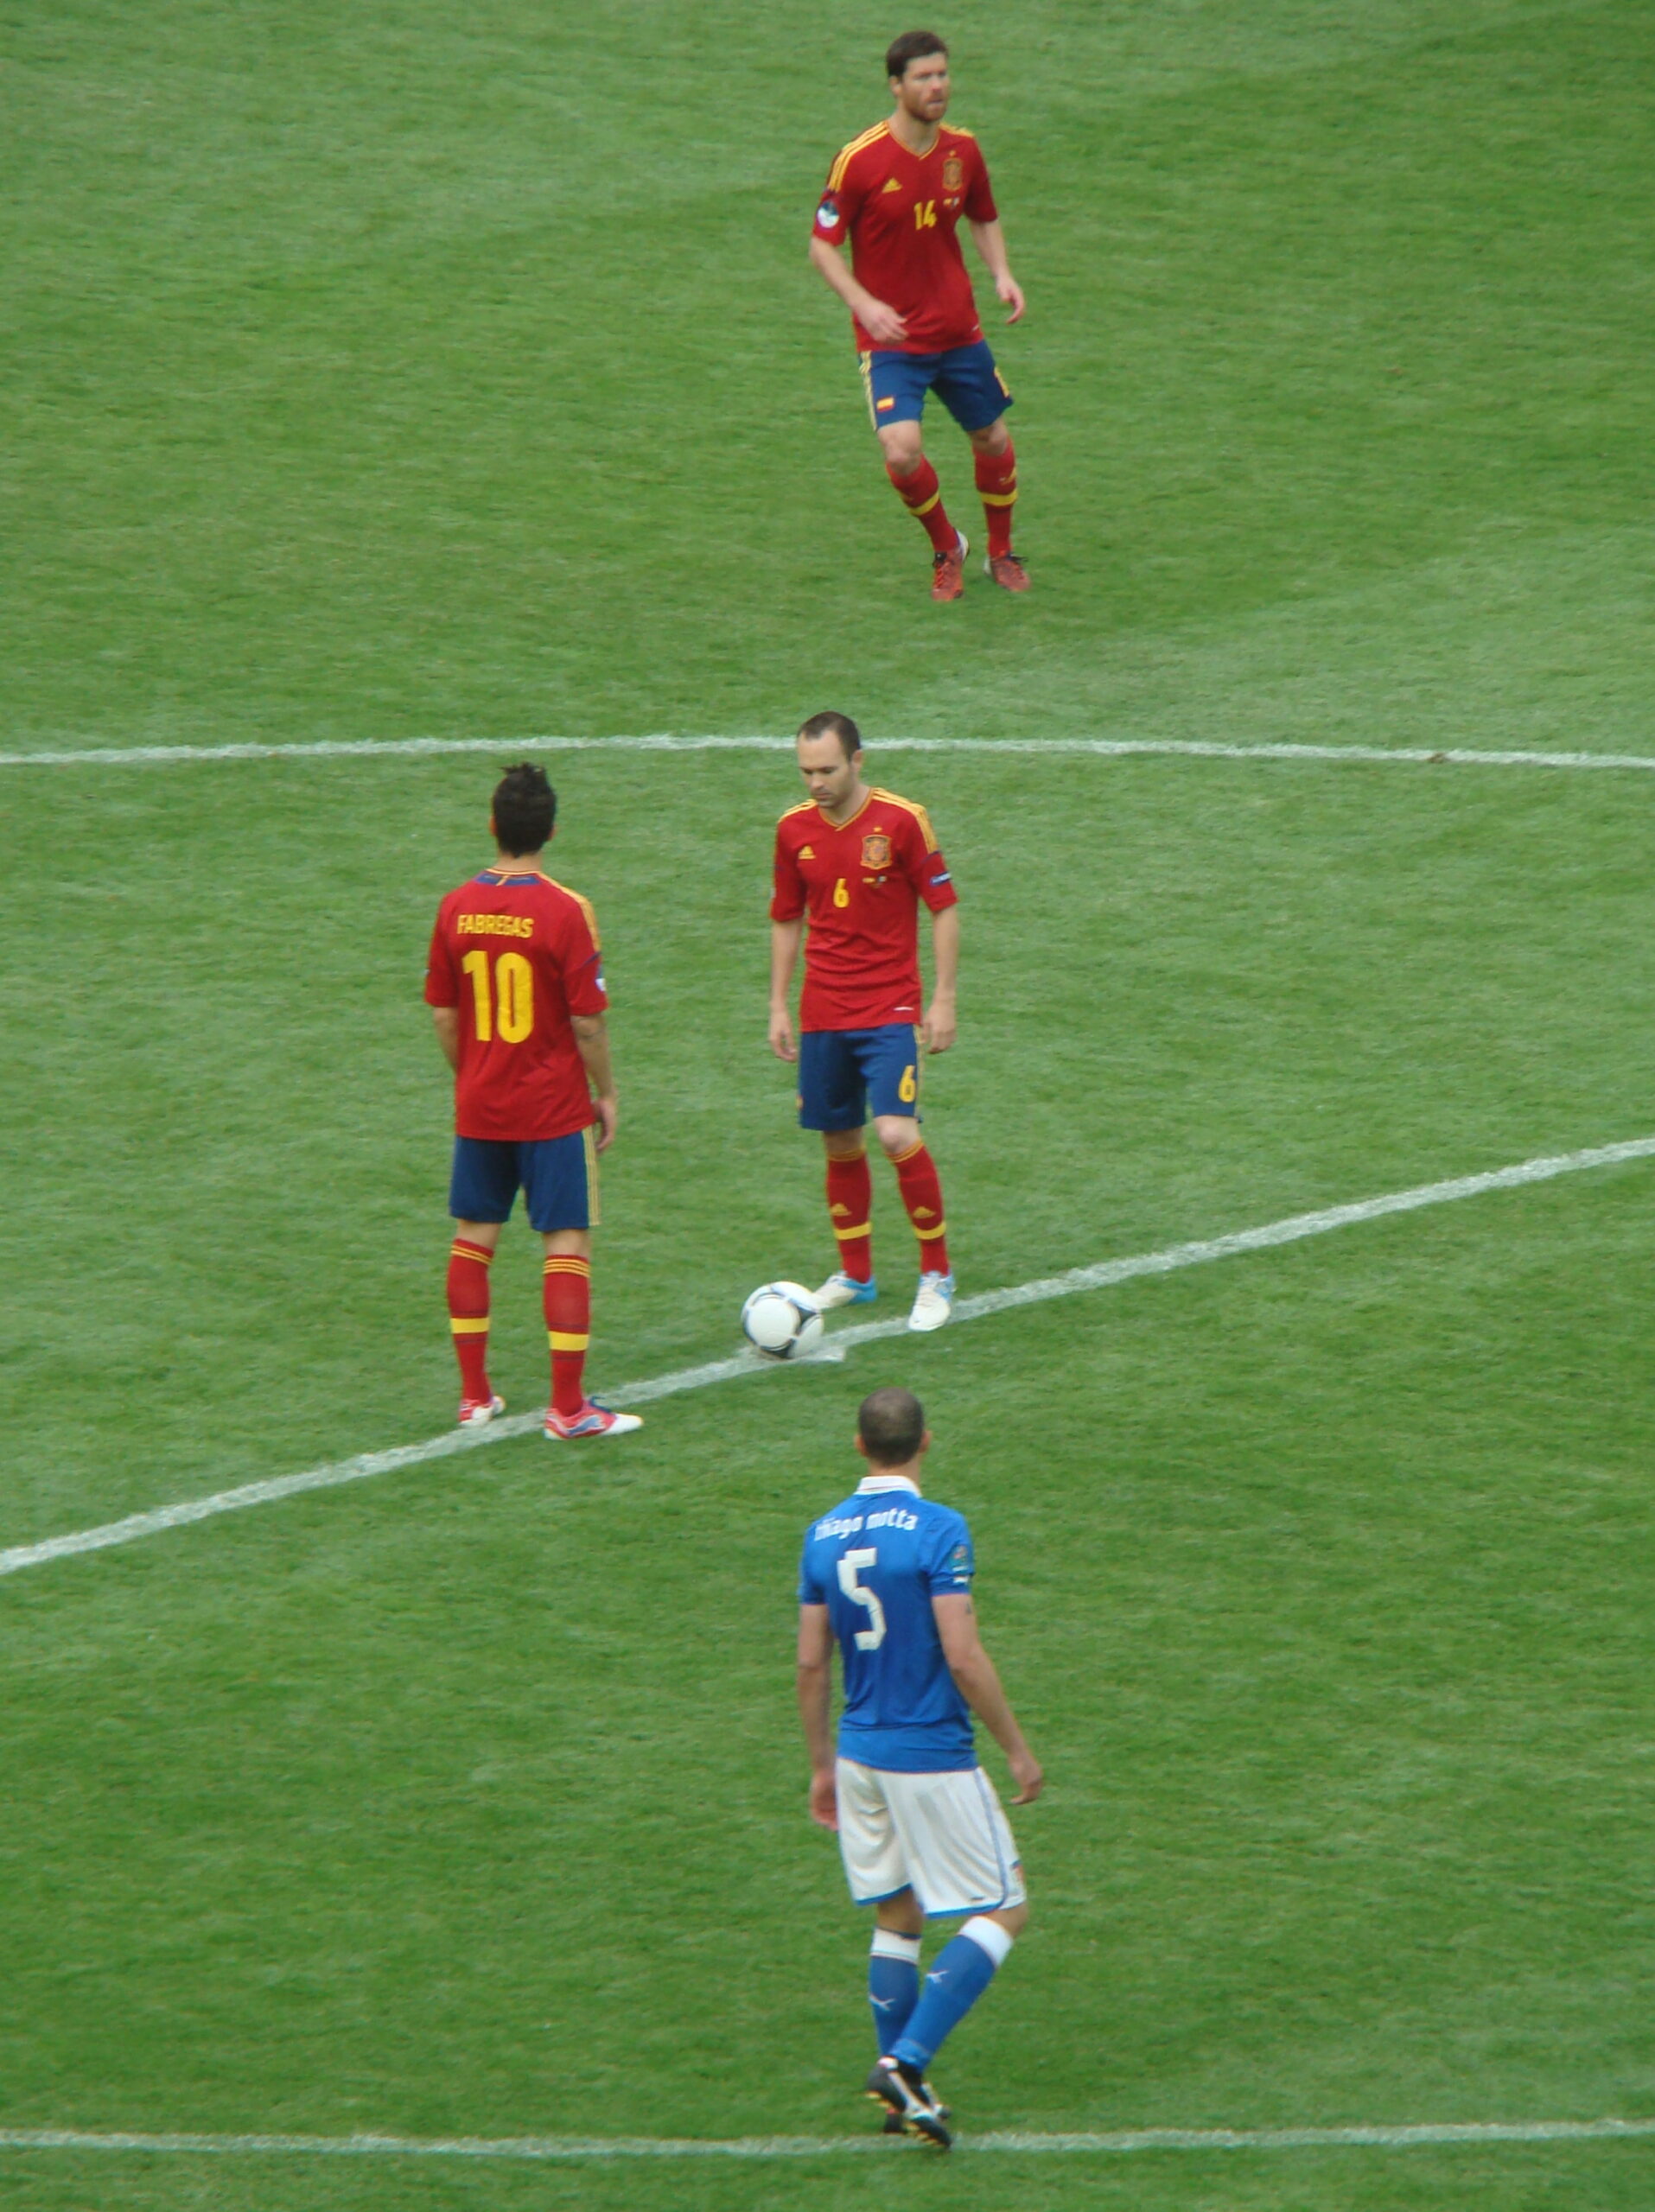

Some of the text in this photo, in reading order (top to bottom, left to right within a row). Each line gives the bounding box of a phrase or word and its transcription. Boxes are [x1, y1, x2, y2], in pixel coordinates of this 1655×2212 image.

[913, 200, 936, 230] 14
[833, 878, 850, 908] 6
[456, 914, 534, 938] FABREGAS
[461, 950, 534, 1044] 10
[898, 1065, 916, 1103] 6
[837, 1547, 888, 1651] 5
